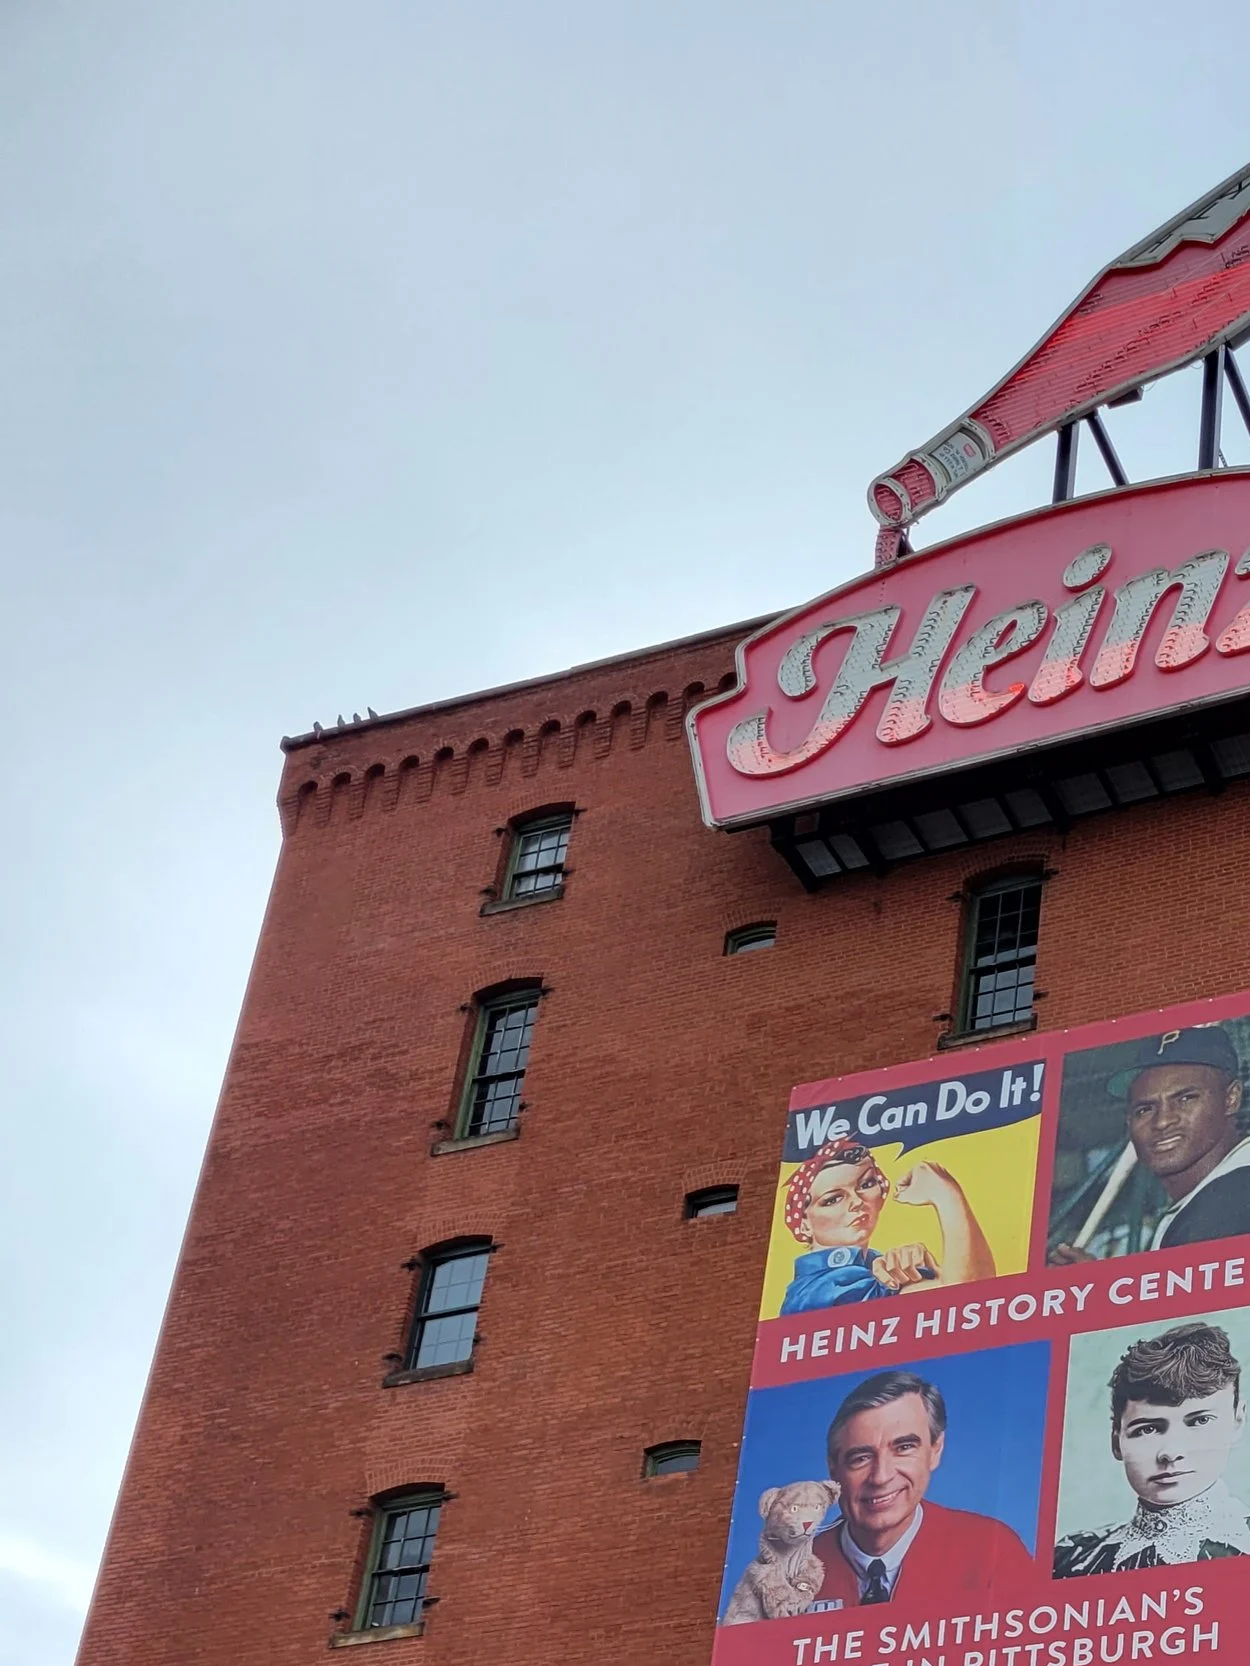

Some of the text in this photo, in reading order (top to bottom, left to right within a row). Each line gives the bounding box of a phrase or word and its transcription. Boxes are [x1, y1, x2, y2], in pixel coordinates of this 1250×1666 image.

[796, 1063, 1045, 1149] We Can Do It!
[779, 1316, 900, 1363] HEINZ
[915, 1282, 1094, 1339] HISTORY
[793, 1586, 1205, 1666] THE SMITHSONIAN'S
